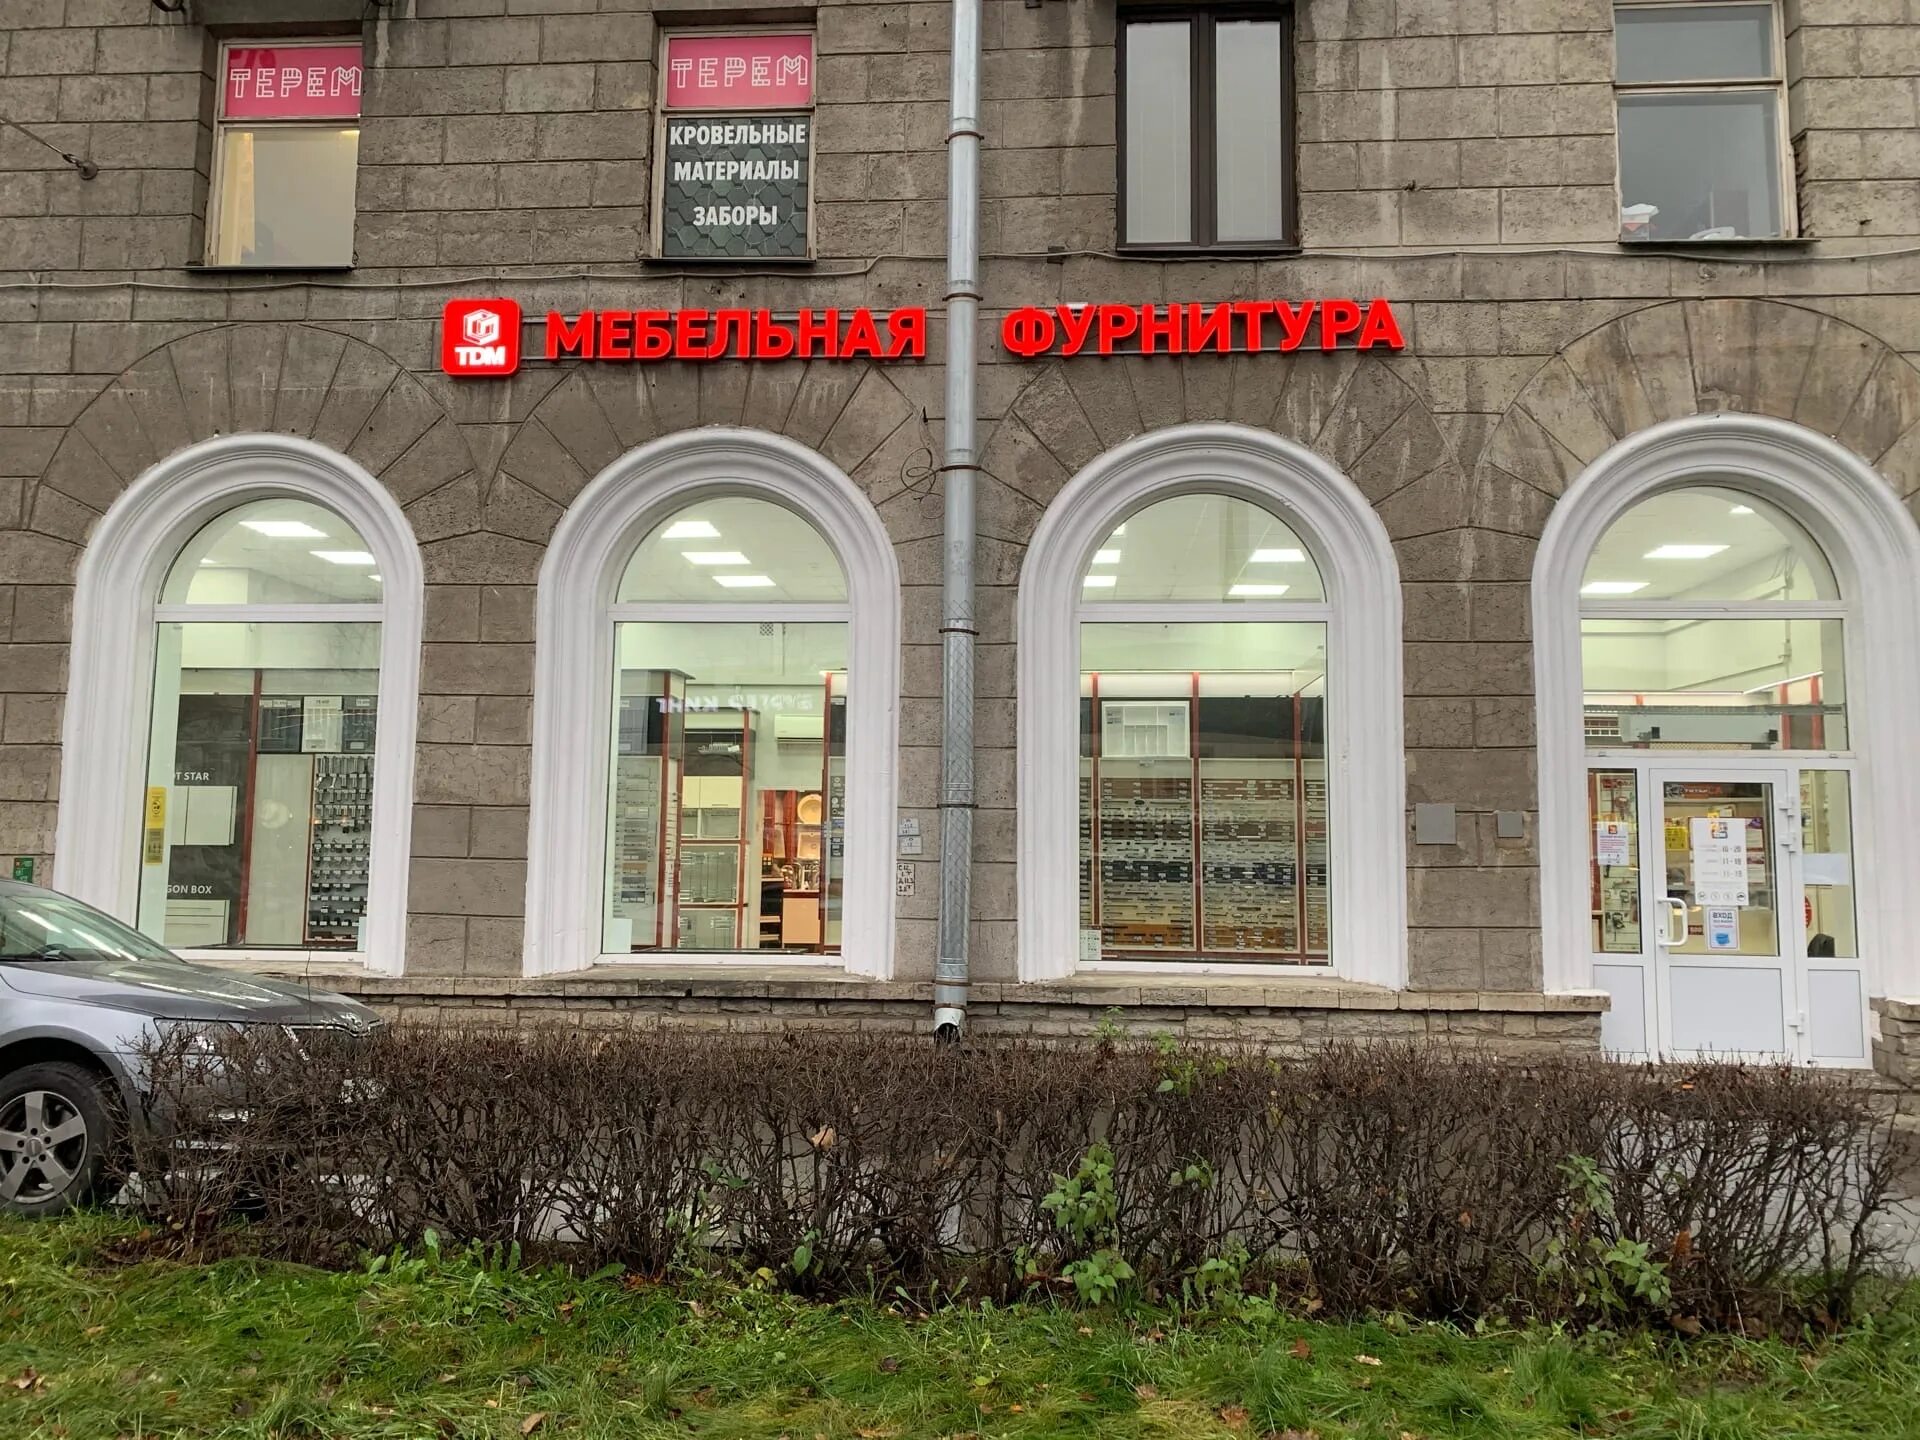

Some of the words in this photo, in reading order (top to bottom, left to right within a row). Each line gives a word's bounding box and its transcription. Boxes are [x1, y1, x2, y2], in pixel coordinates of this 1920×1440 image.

[230, 66, 362, 98] ТЕРЕМ
[671, 55, 809, 88] ТЕРЕМ
[670, 124, 806, 145] КРОВЕЛЬНЫЕ
[674, 160, 799, 181] МАТЕРИАЛЫ
[693, 206, 778, 226] ЗАБОРЫ
[545, 307, 927, 362] МЕБЕЛЬНАЯ
[1001, 298, 1406, 358] ФУРНИТУРА
[454, 346, 506, 366] TDM
[183, 771, 210, 781] STAR
[191, 884, 212, 894] BOX
